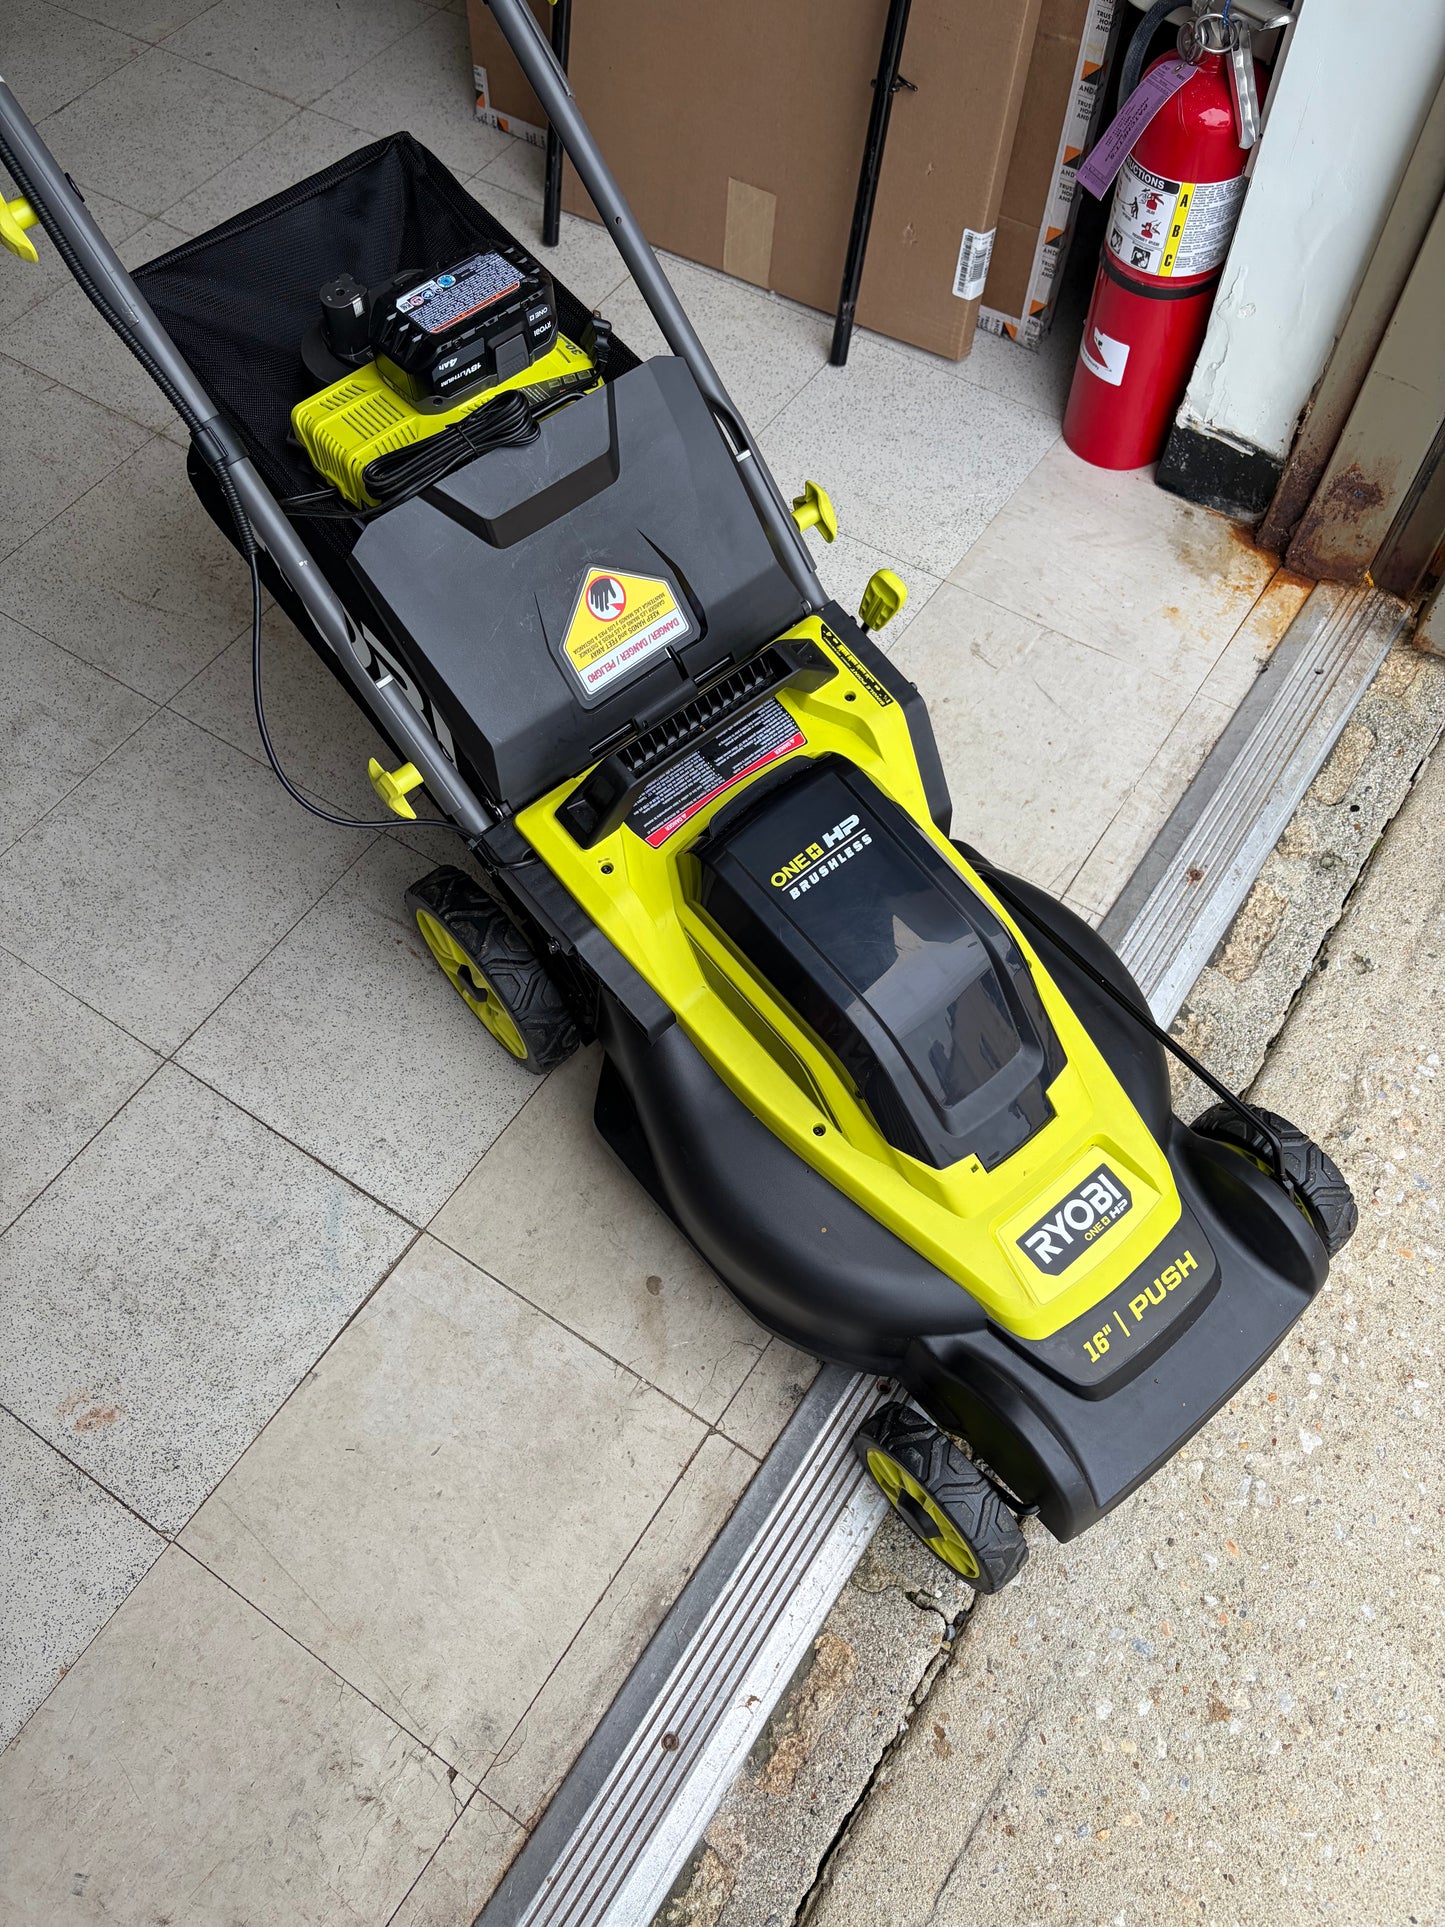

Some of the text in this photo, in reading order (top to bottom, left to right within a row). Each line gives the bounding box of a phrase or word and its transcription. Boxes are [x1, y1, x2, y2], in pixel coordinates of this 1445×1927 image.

[1097, 10, 1112, 20] TRUS
[1078, 84, 1096, 96] AND
[1078, 100, 1092, 109] TRUS
[1060, 168, 1075, 178] AND
[1126, 156, 1166, 190] RUCTIONS
[1180, 194, 1189, 208] A
[1172, 225, 1181, 238] B
[1164, 254, 1173, 267] C
[532, 321, 553, 337] RYOBI
[438, 356, 459, 371] 4Ah
[590, 610, 660, 659] KEEP HANDS and FEET AWAY
[650, 618, 680, 641] DANGER
[620, 638, 648, 661] DANGER
[587, 659, 616, 683] PELIGRO
[774, 742, 791, 755] DANGER
[664, 816, 682, 831] DANGER
[822, 814, 860, 848] HP
[789, 834, 872, 900] BRUSHLESS
[1109, 1198, 1128, 1220] HP
[1024, 1173, 1122, 1264] RYOBI
[1128, 1250, 1198, 1322] PUSH
